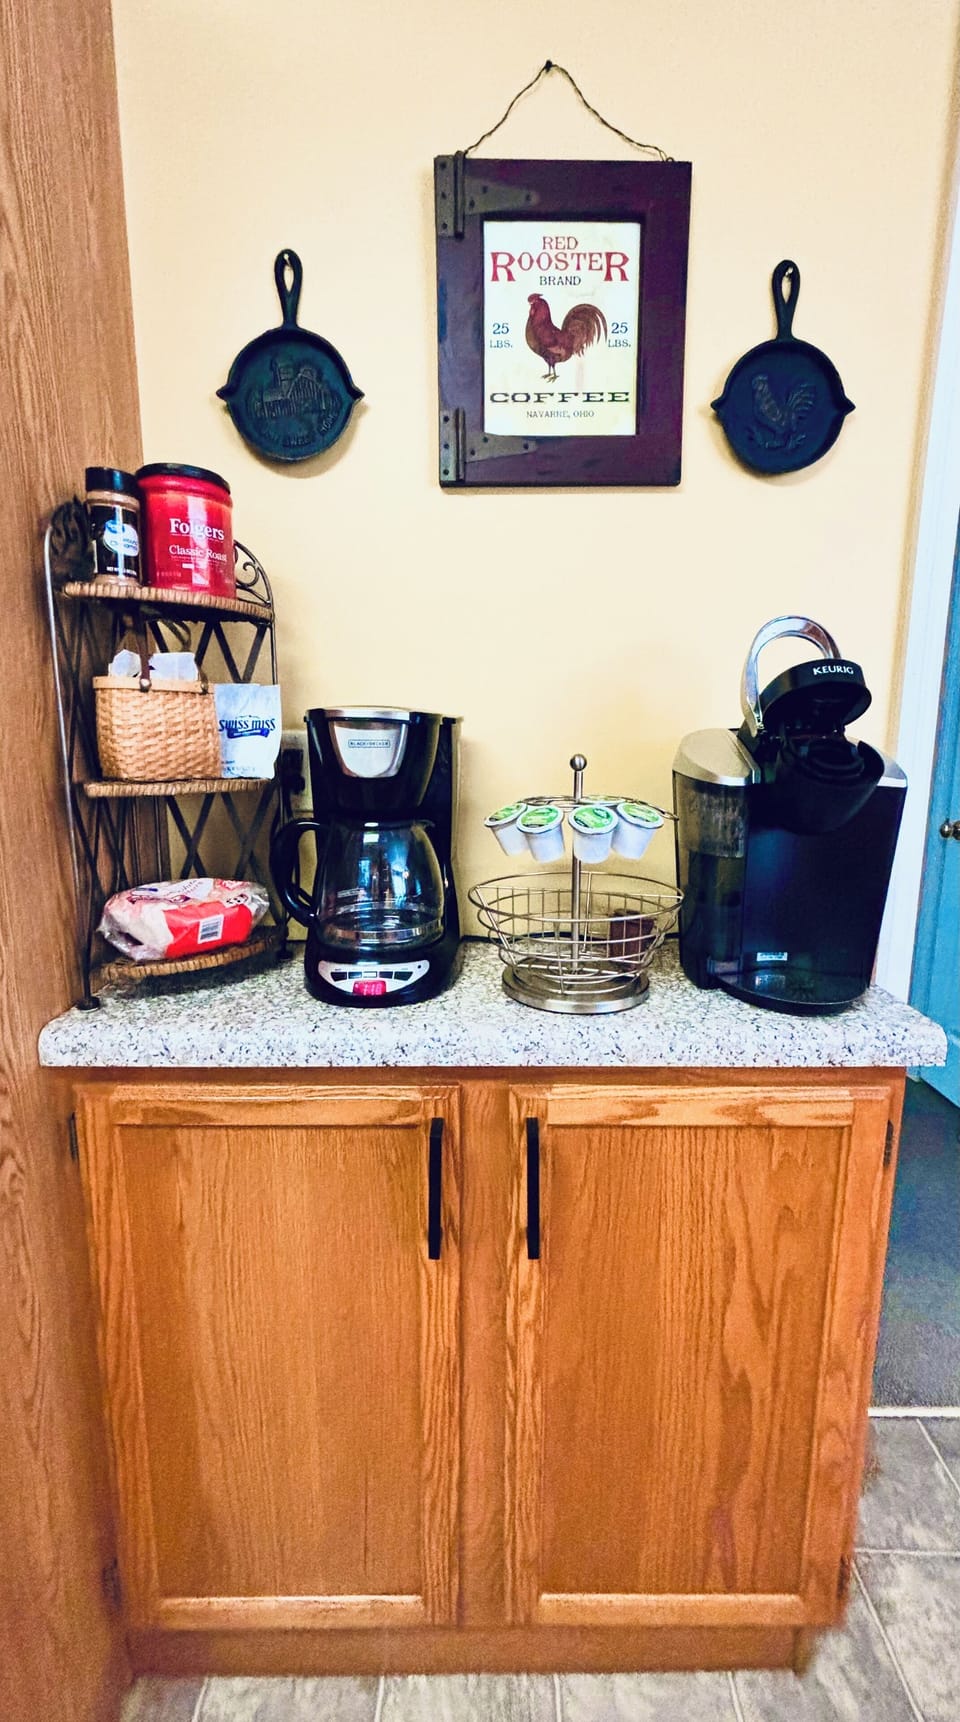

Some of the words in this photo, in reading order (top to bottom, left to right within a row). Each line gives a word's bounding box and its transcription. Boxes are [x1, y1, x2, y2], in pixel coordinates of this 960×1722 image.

[542, 236, 579, 250] RED
[490, 252, 630, 281] ROOSTER
[539, 275, 582, 286] BRAND
[492, 322, 510, 335] 25
[611, 322, 629, 334] 25
[489, 339, 513, 348] LBS.
[607, 339, 632, 348] LBS.
[489, 392, 630, 403] COFFEE
[572, 410, 595, 418] OHIO
[168, 517, 225, 541] Folgers
[168, 544, 205, 558] Classic
[812, 665, 854, 676] KEURIG
